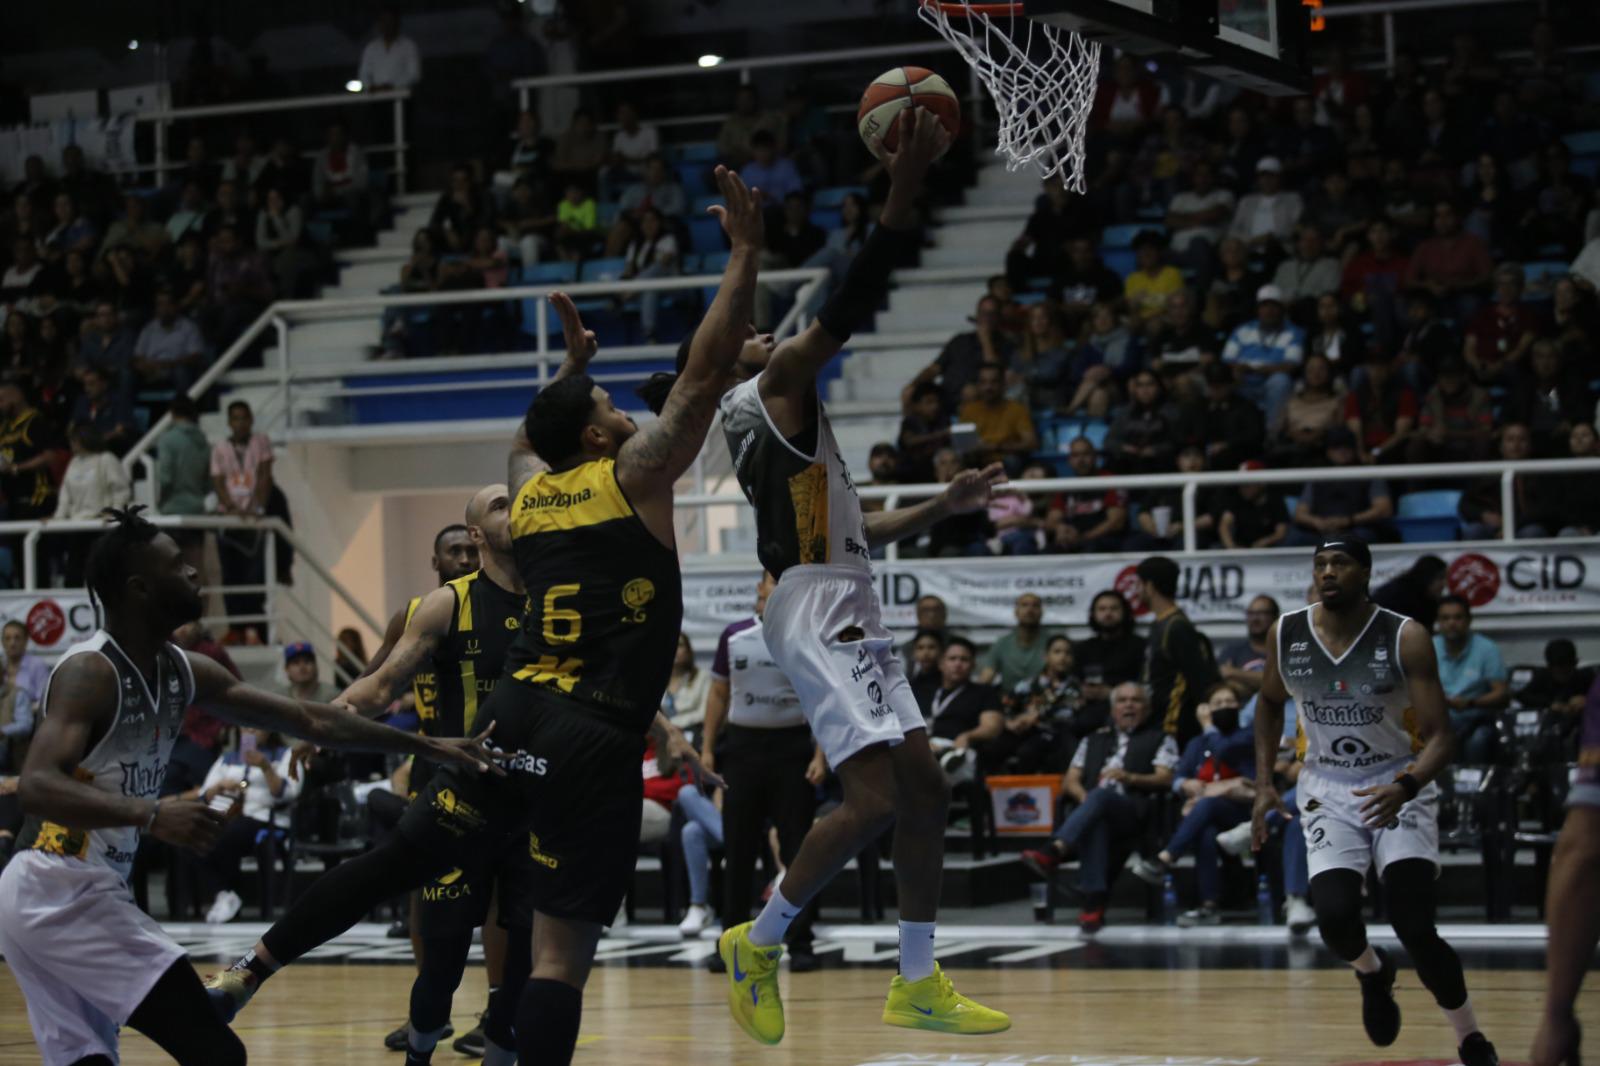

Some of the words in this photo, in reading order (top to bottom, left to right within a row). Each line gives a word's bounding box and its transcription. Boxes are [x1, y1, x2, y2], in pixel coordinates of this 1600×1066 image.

[874, 573, 920, 605] ID
[1506, 556, 1585, 591] CID
[542, 583, 582, 647] 6
[422, 883, 472, 901] MEGA
